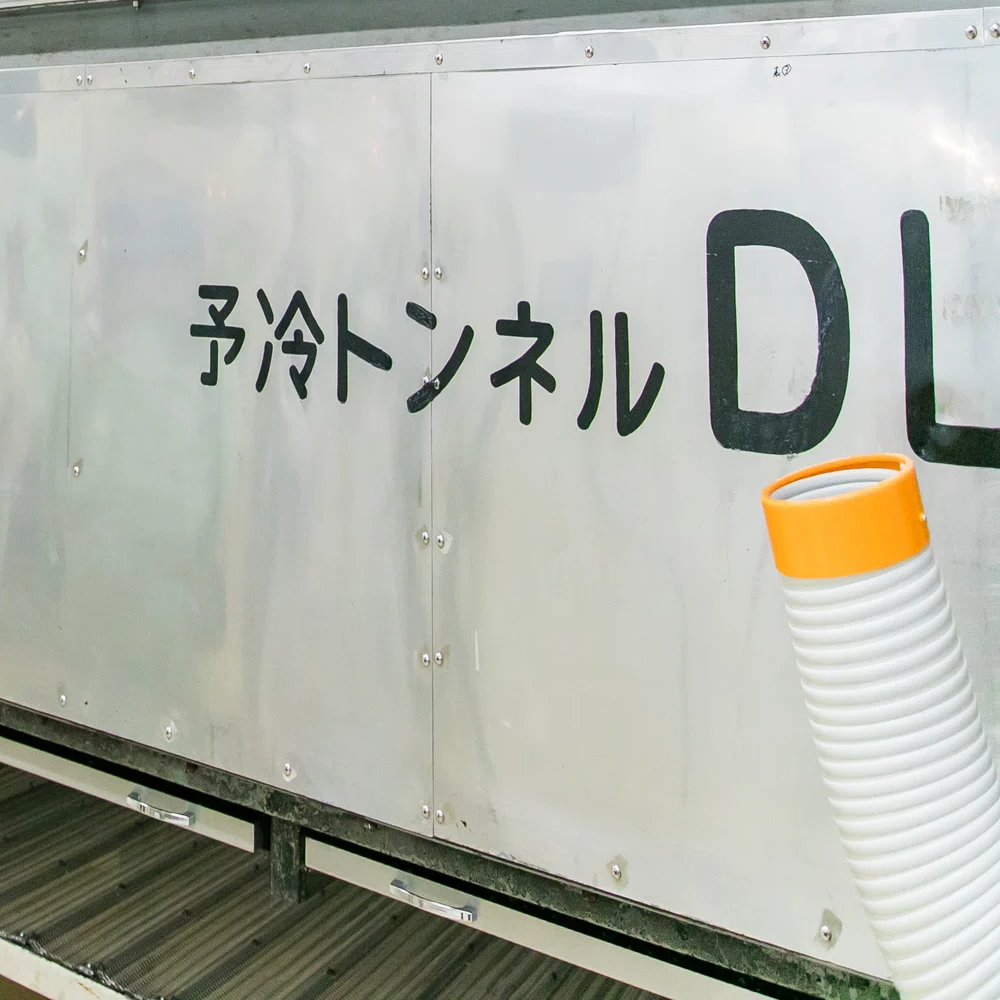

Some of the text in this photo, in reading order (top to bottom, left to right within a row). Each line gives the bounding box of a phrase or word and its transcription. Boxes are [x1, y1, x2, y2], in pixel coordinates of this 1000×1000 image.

[189, 208, 1000, 469] 予冷トンネル DL
